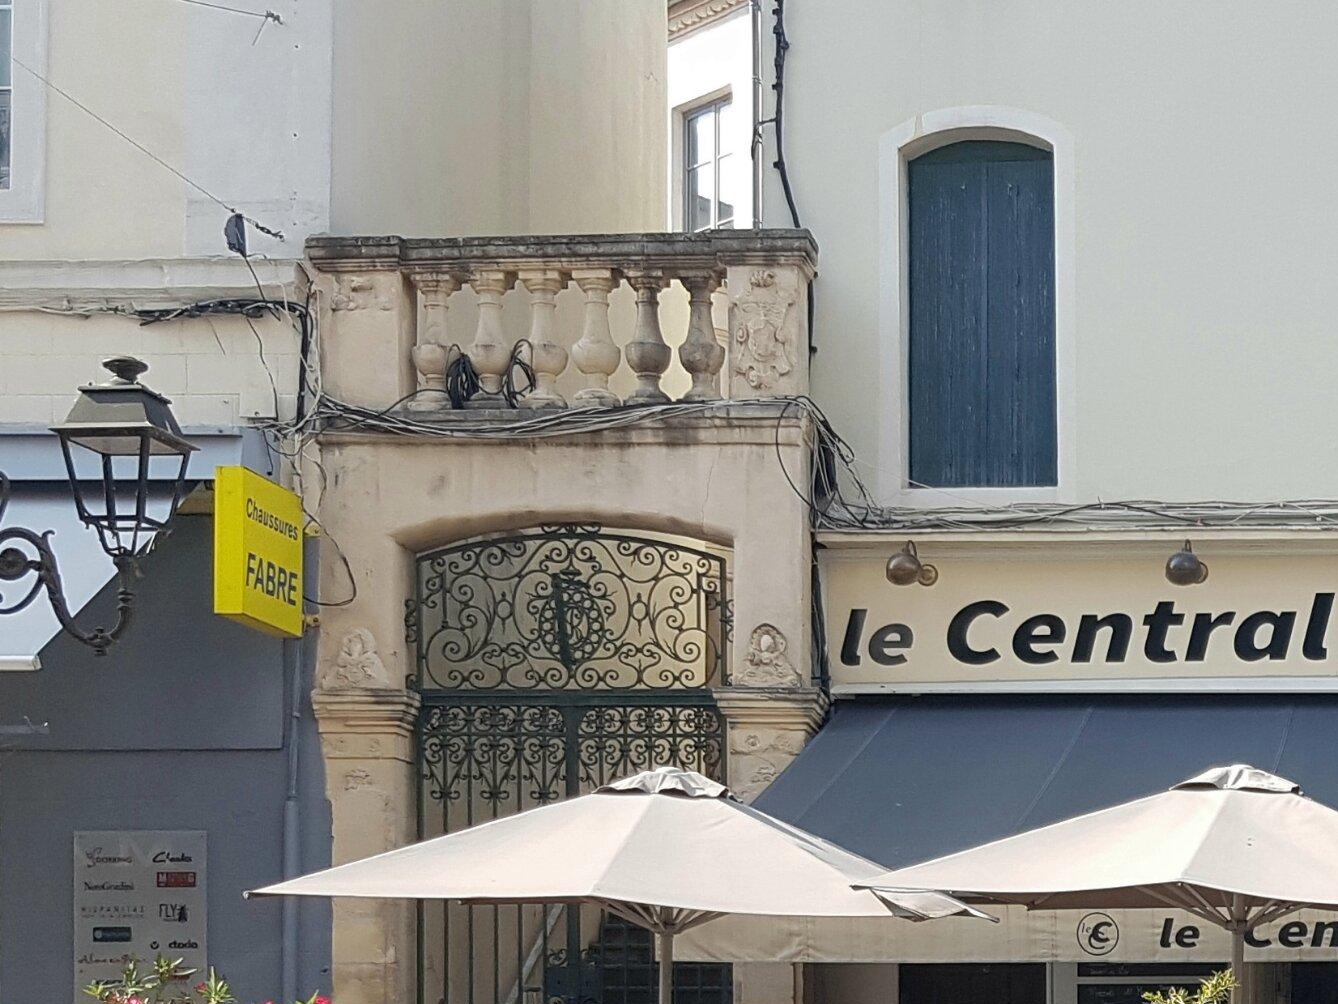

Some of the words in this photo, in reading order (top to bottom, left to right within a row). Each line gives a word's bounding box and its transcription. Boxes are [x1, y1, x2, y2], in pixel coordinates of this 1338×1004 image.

[246, 497, 298, 541] Chaussures
[245, 552, 298, 606] FABRE
[840, 608, 914, 666] le
[946, 592, 1335, 664] Central
[1159, 918, 1200, 949] le
